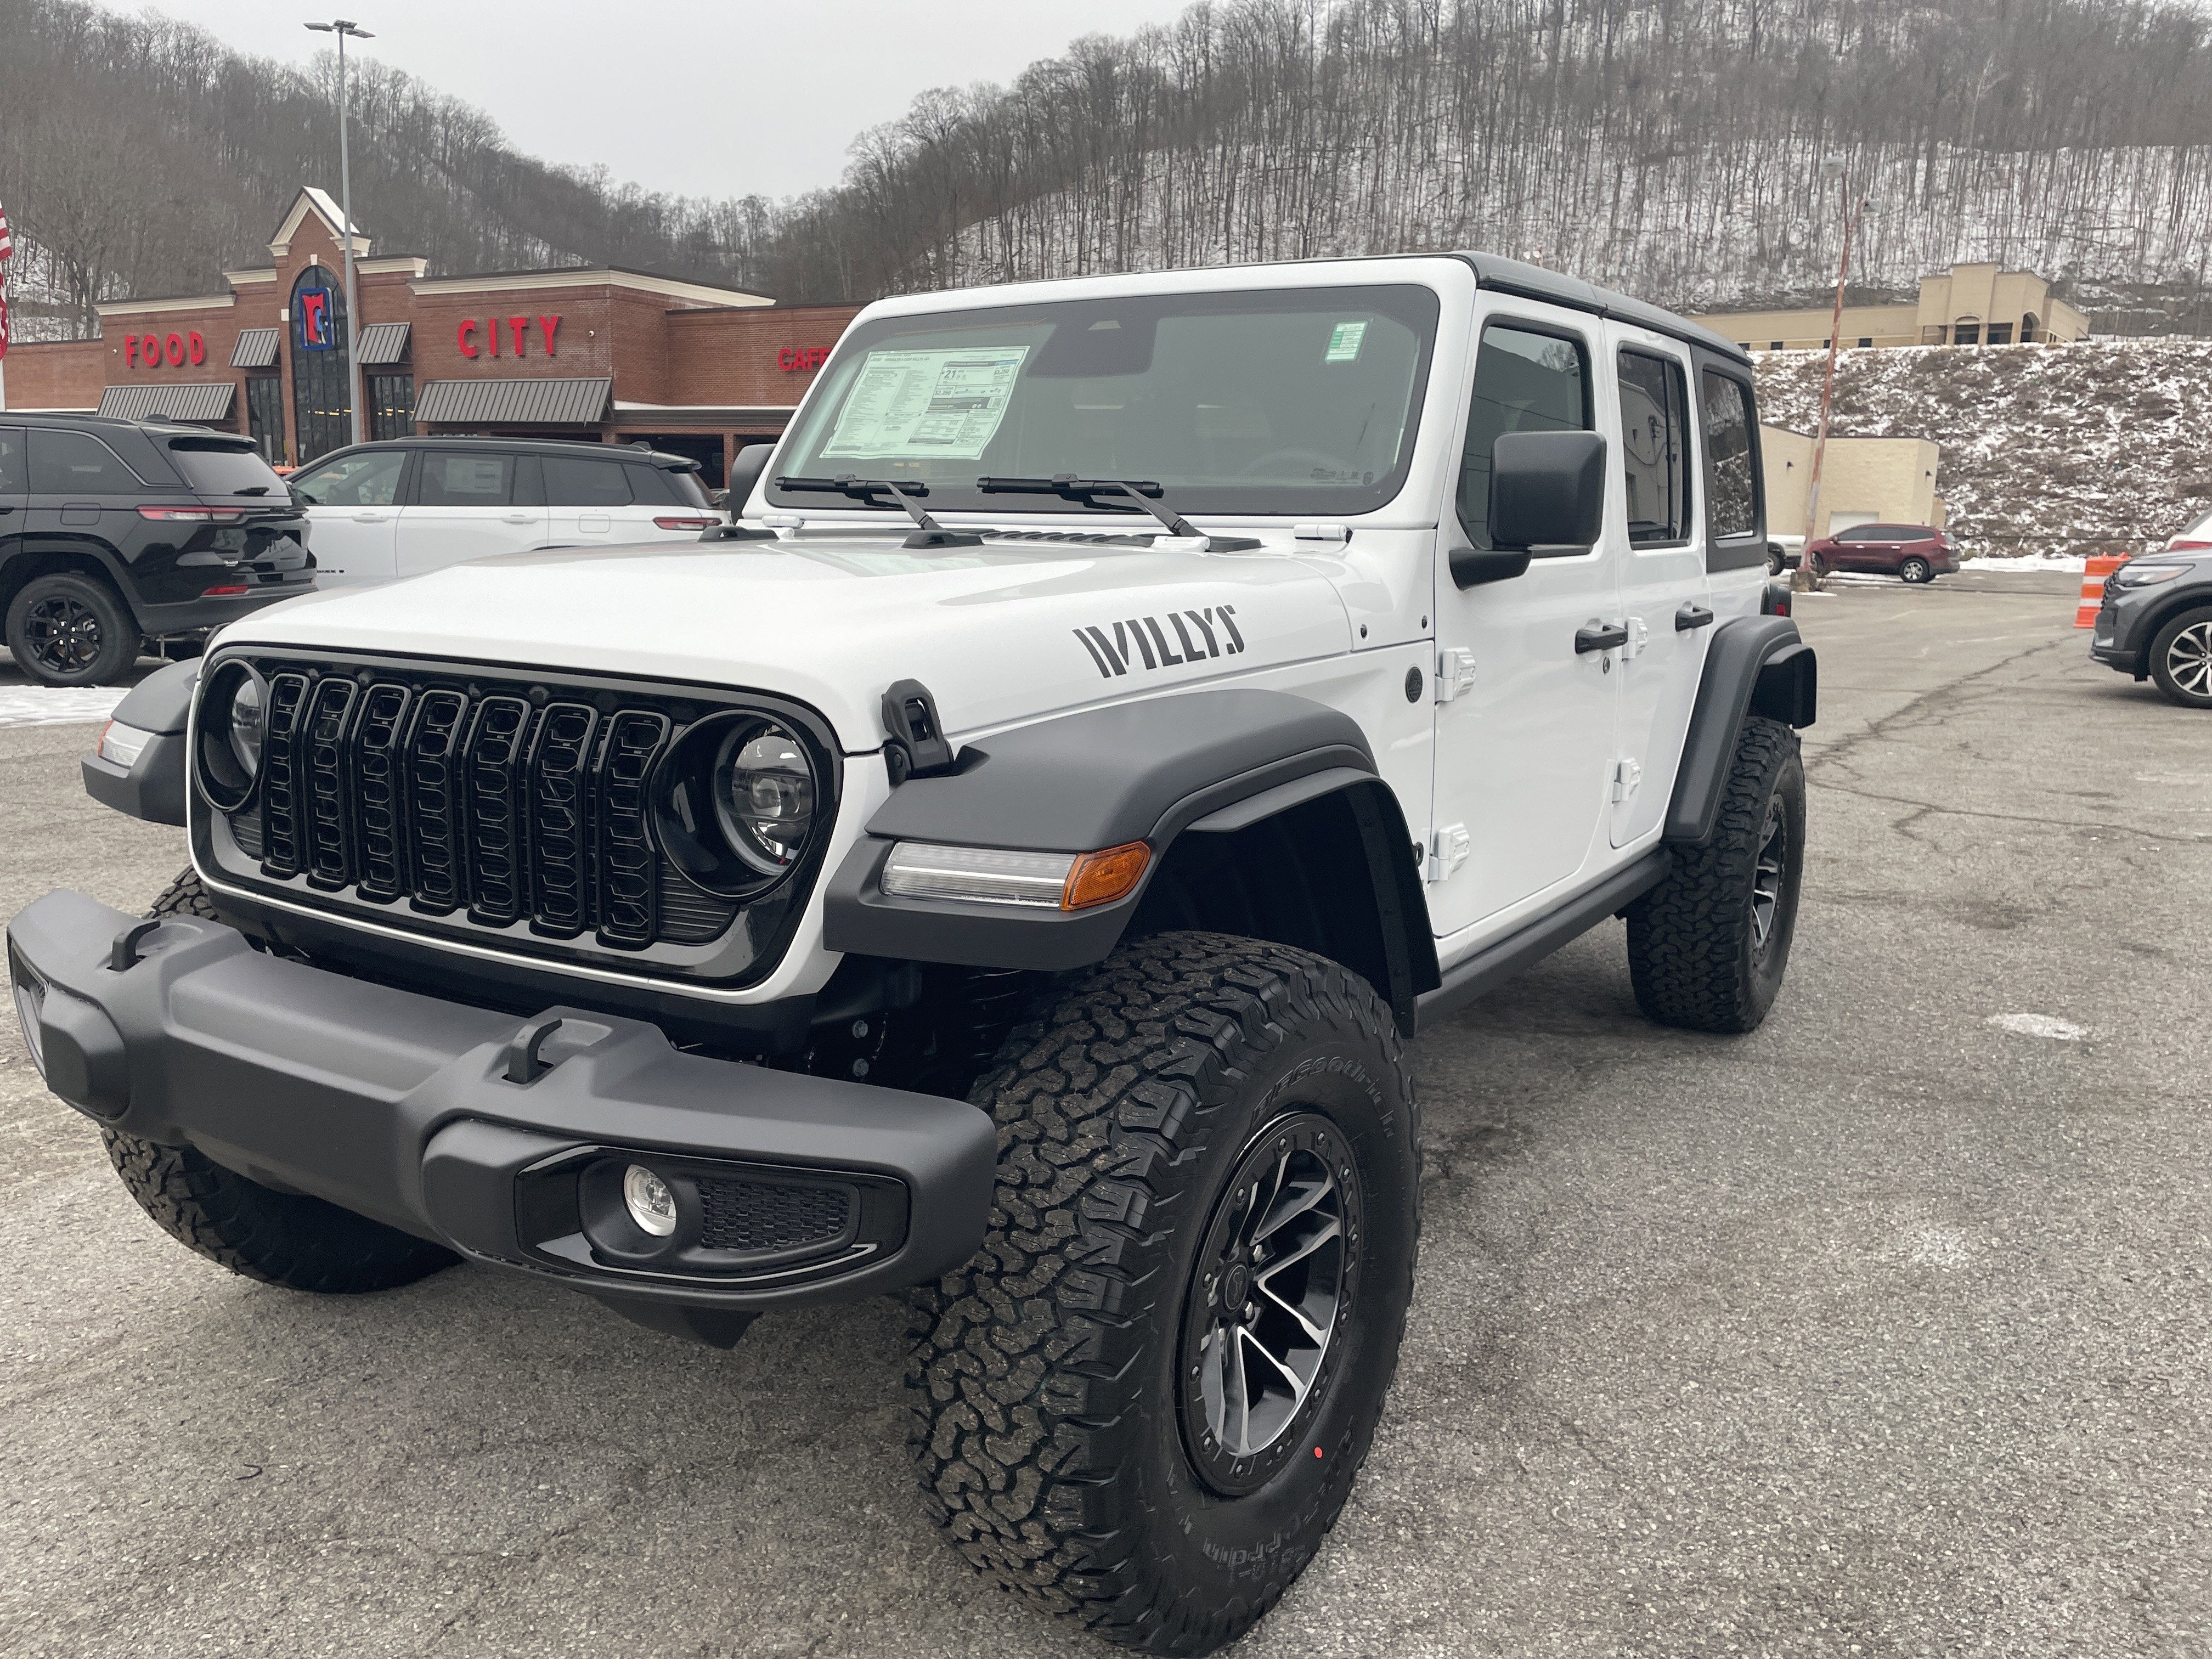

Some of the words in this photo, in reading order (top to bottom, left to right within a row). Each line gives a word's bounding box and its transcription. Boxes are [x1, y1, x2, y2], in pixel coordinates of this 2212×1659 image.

[125, 331, 204, 367] FOOD
[457, 315, 559, 358] CITY
[944, 370, 957, 379] 21
[1072, 605, 1245, 679] WILLYS
